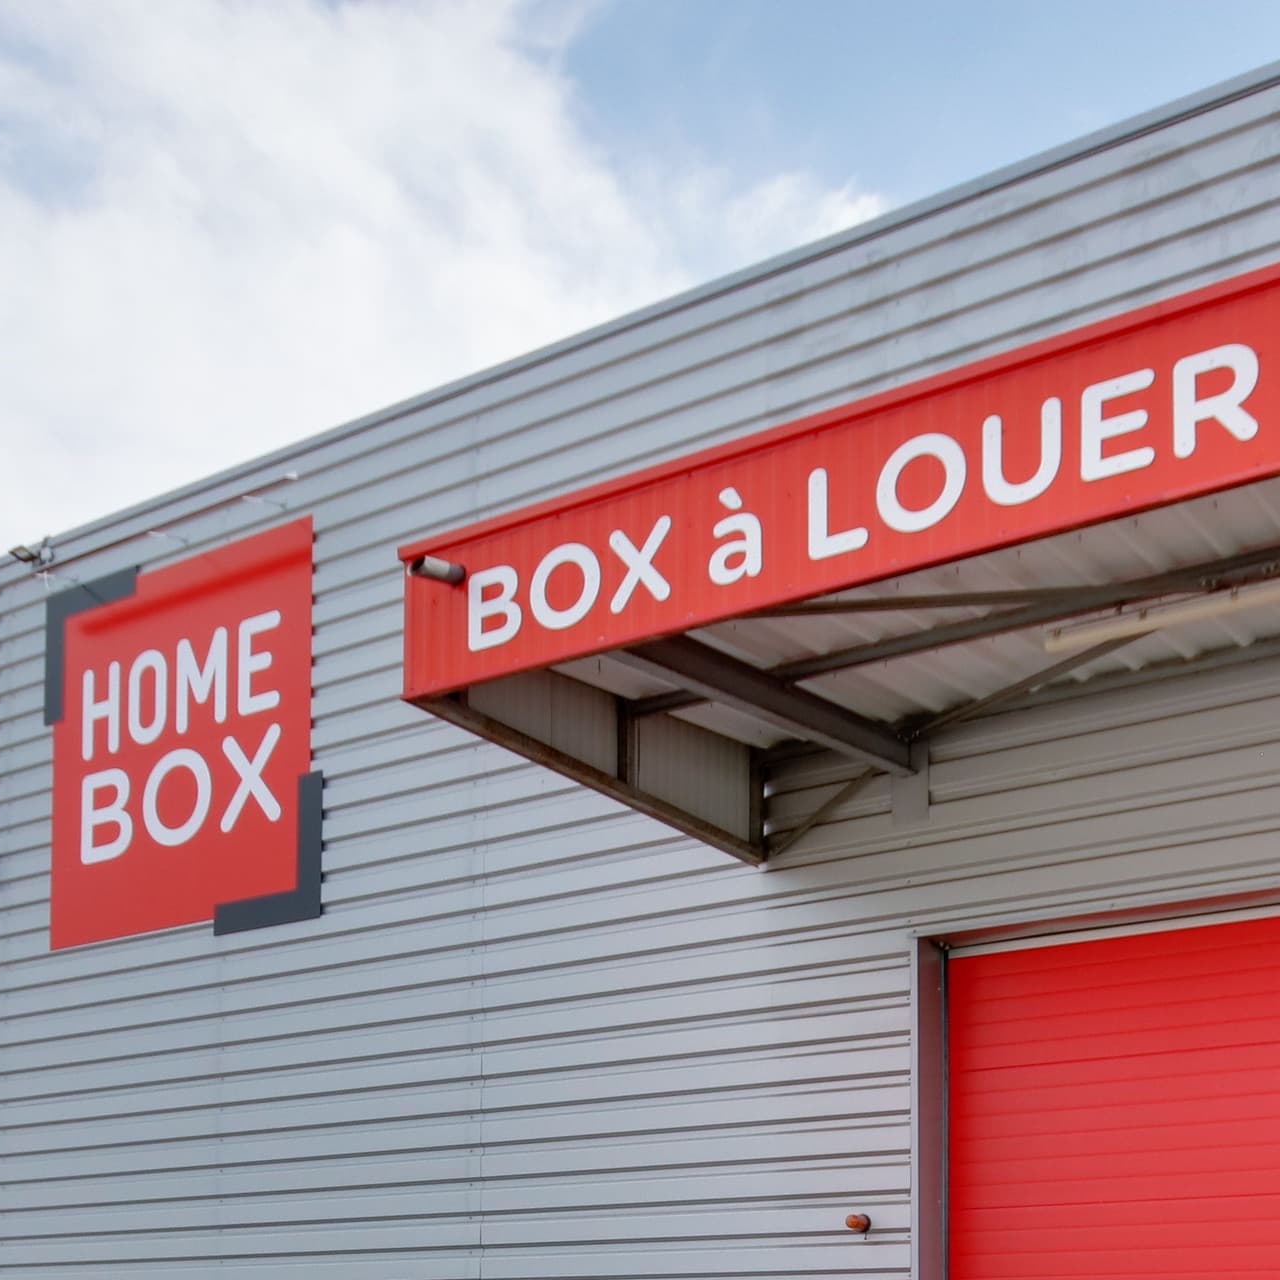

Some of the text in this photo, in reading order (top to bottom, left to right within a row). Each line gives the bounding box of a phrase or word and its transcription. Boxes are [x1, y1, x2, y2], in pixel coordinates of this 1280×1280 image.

[467, 515, 673, 652] BOX
[708, 487, 763, 586] à
[807, 342, 1260, 561] LOUER
[81, 609, 282, 762] HOME
[79, 722, 282, 866] BOX
